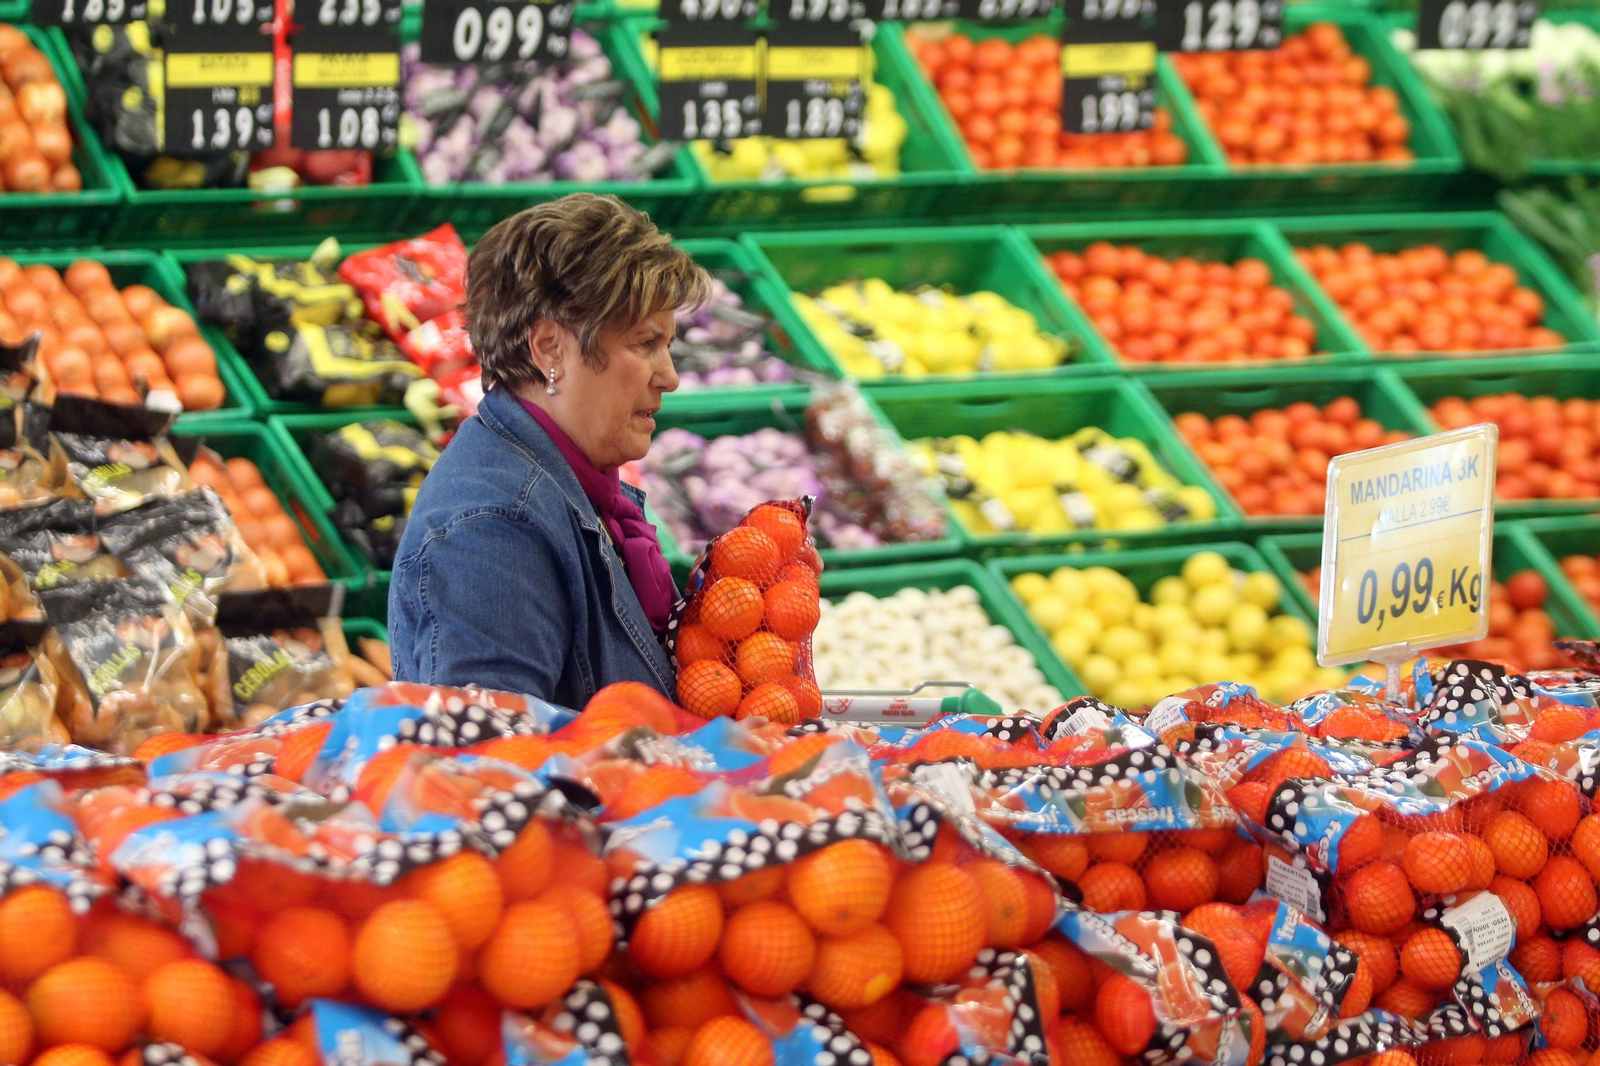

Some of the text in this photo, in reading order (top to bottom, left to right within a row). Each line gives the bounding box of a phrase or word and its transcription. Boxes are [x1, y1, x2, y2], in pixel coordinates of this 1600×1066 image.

[1350, 454, 1480, 506] MANDARINA 3K
[1357, 557, 1434, 632] 0,99
[1105, 805, 1176, 824] frescas
